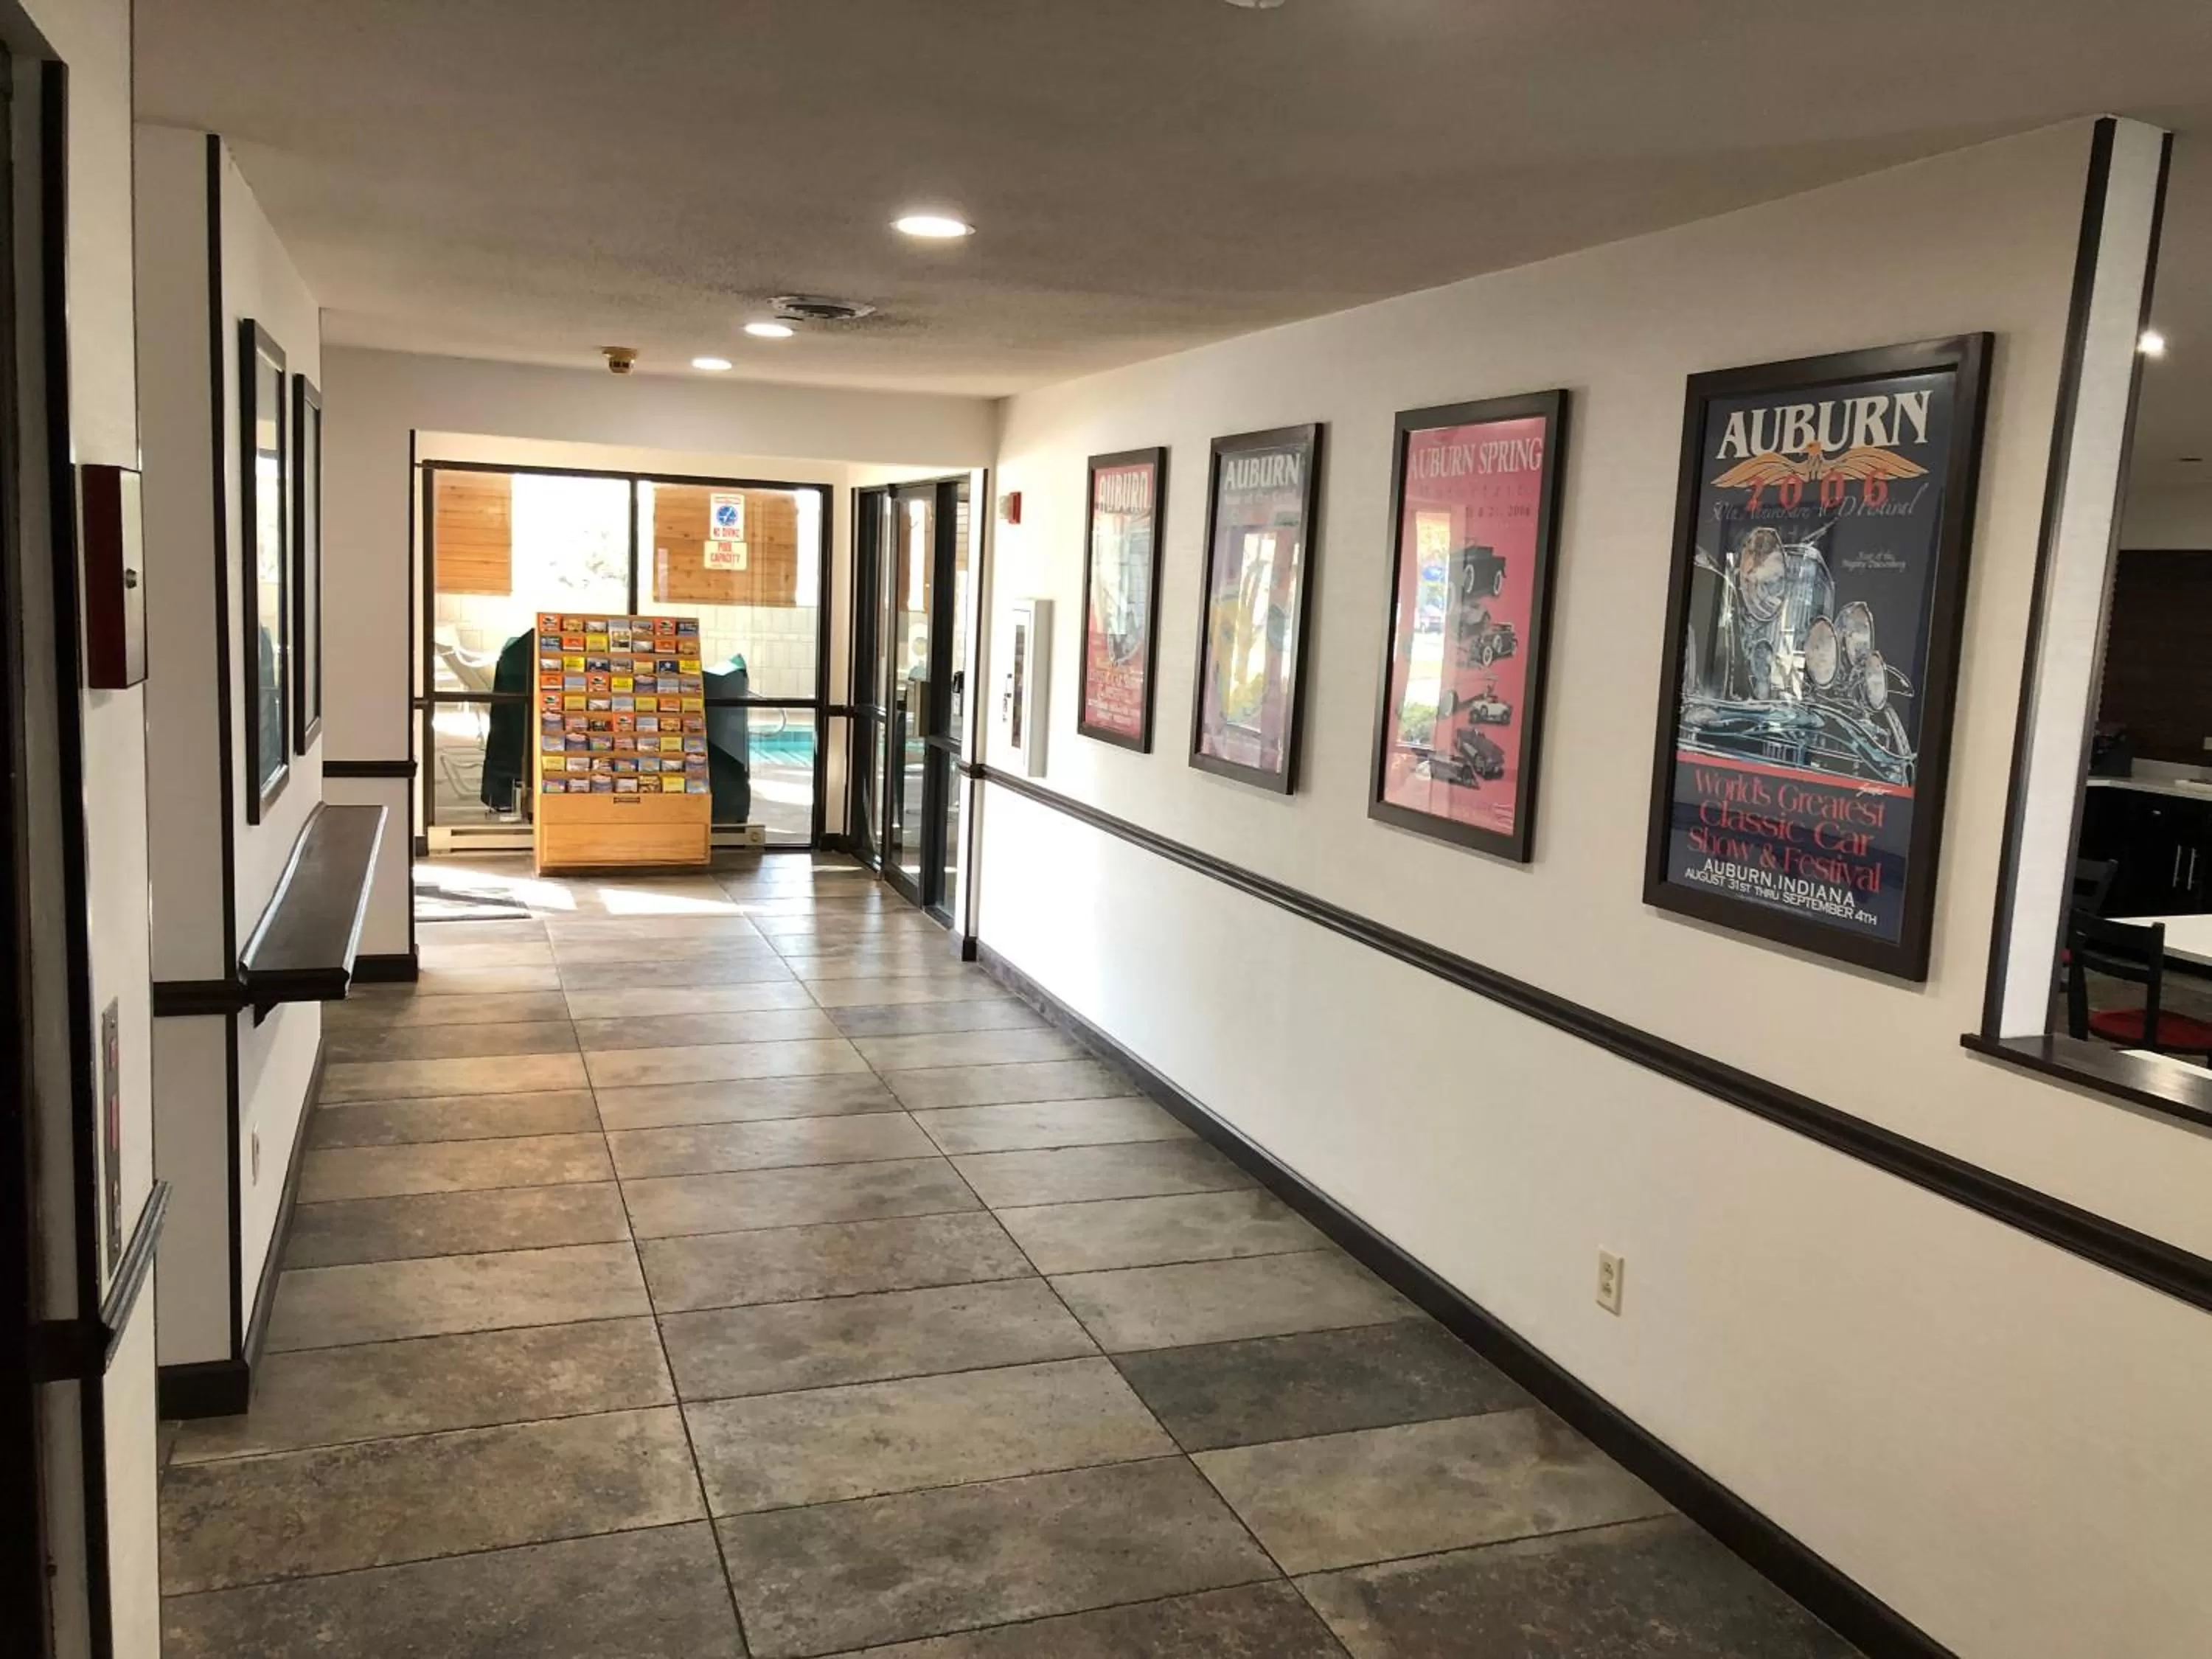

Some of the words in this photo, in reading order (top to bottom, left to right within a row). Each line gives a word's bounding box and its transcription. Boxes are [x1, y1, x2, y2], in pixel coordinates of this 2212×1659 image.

[1715, 390, 1933, 459] AUBURN
[1224, 453, 1301, 490] AUBURN
[1408, 443, 1477, 480] AUBURN
[1478, 437, 1543, 474] SPRING
[1745, 468, 1889, 512] 2006
[1699, 799, 1805, 843] Classic
[1814, 820, 1875, 856] Car
[1778, 783, 1886, 828] Greatest
[1687, 826, 1754, 861] Show
[1759, 843, 1777, 870] &
[1783, 846, 1883, 894] Festival
[1684, 866, 1725, 887] AUGUST
[1755, 886, 1779, 901] THRU
[1781, 891, 1854, 920] SEPTEMBER
[1854, 909, 1878, 926] 4TH
